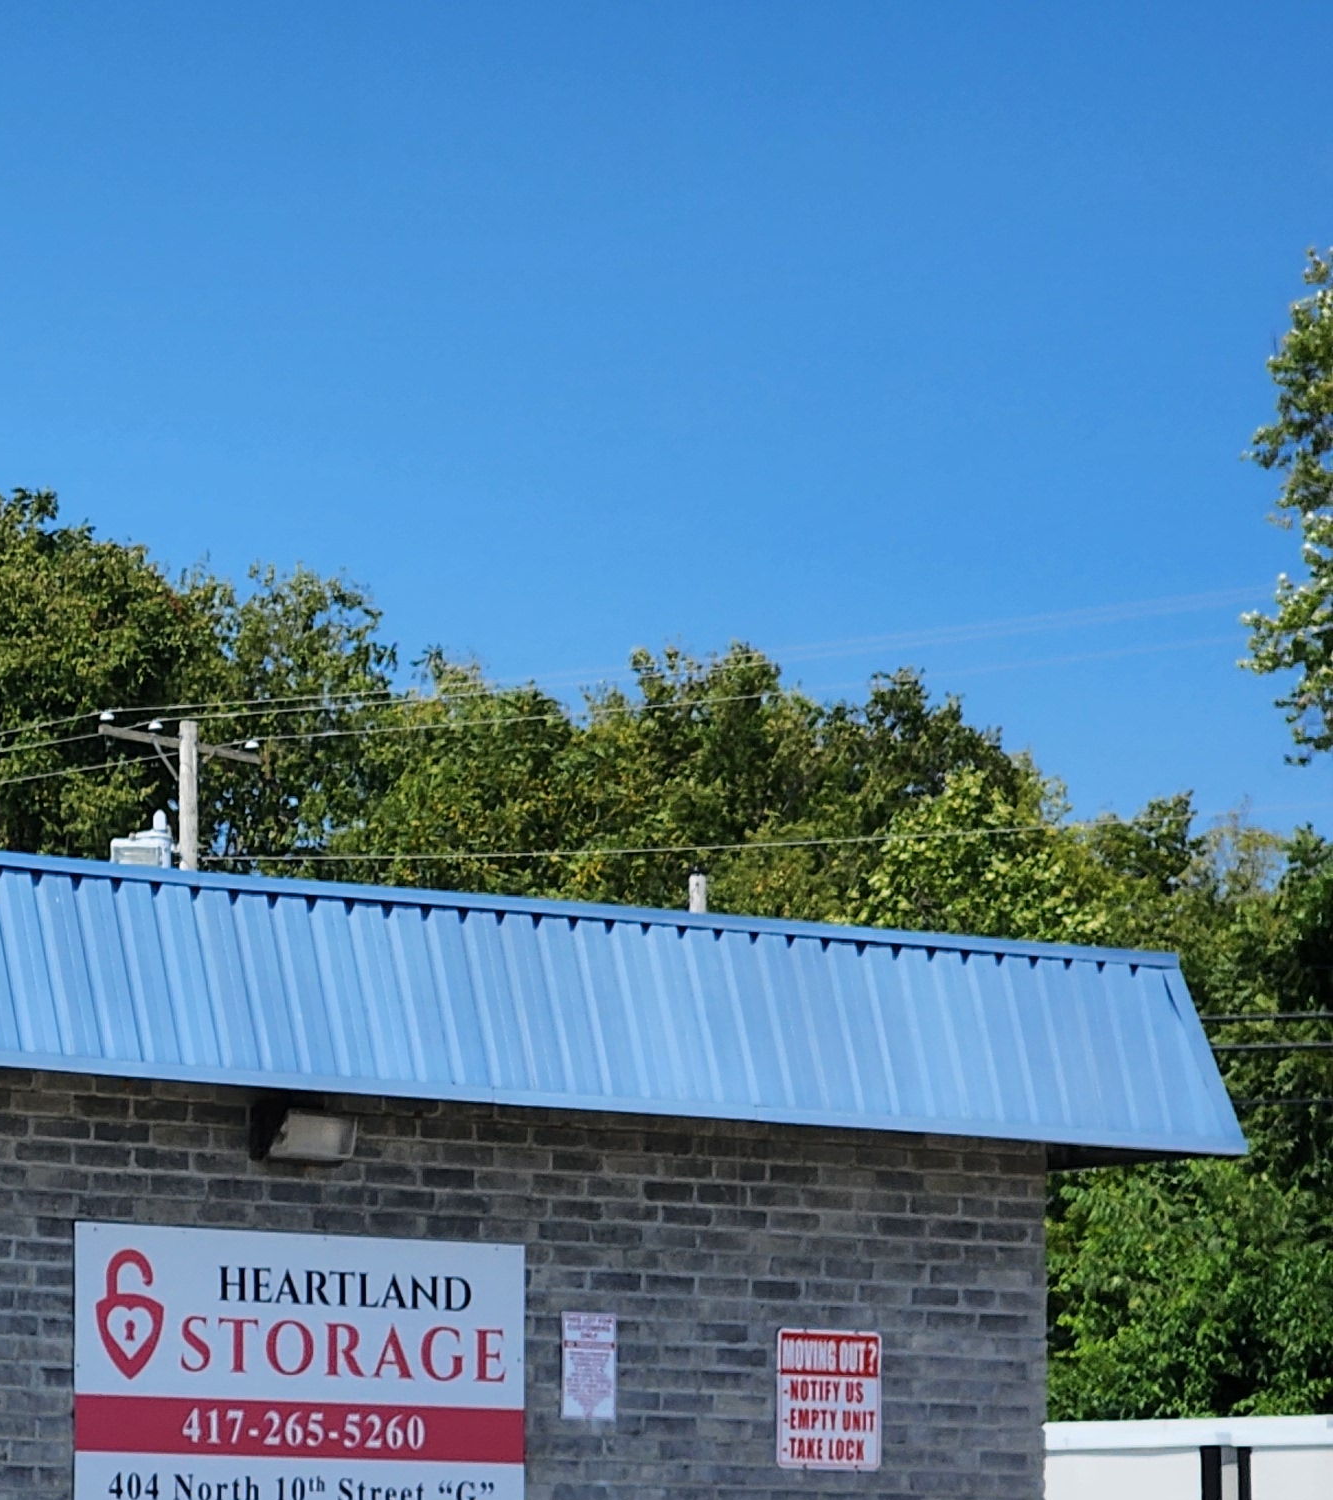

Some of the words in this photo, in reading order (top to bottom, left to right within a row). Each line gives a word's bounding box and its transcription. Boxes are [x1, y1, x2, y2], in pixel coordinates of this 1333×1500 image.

[219, 1265, 472, 1312] HEARTLAND
[181, 1315, 506, 1382] STORAGE
[783, 1339, 836, 1371] MOVING
[839, 1341, 866, 1373] OUT
[846, 1381, 864, 1403] US
[182, 1407, 426, 1451] 417-265-5260
[842, 1410, 875, 1432] UNIT
[828, 1439, 864, 1460] LOCK
[108, 1471, 160, 1500] 404
